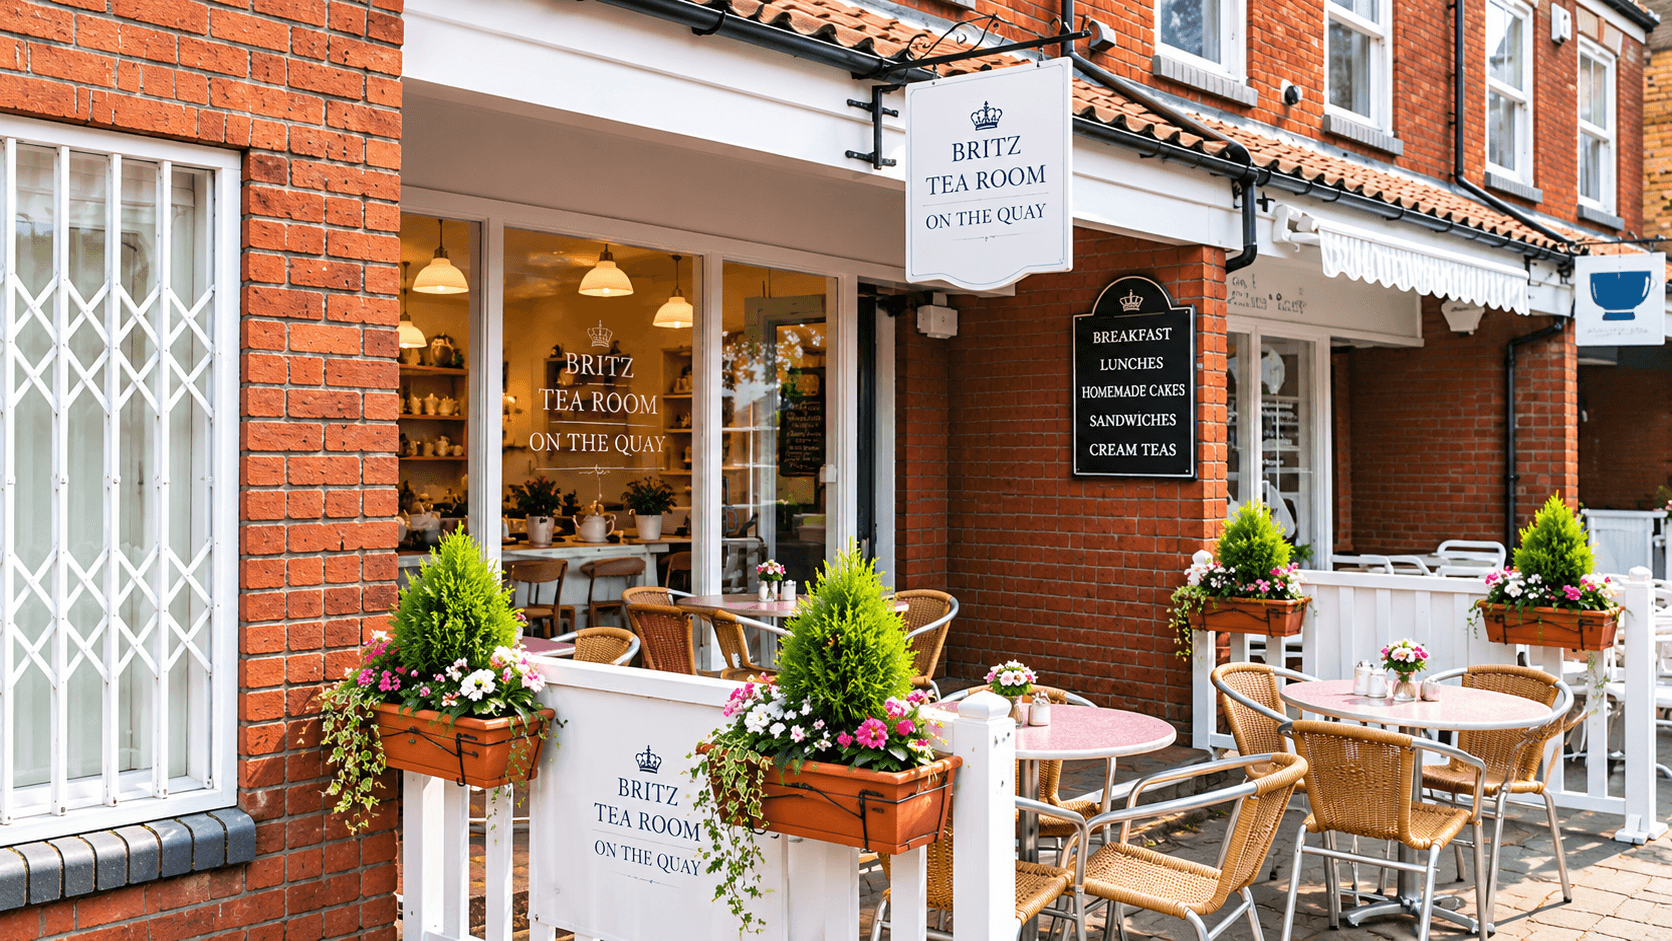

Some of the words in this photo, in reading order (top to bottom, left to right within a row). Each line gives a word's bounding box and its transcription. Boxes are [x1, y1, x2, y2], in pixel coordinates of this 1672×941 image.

[951, 135, 1021, 162] BRITZ
[925, 174, 969, 195] TEA
[976, 164, 1046, 190] ROOM
[925, 213, 951, 229] ON
[956, 209, 992, 226] THE
[997, 203, 1046, 224] QUAY
[1093, 327, 1172, 344] BREAKFAST
[565, 352, 634, 378] BRITZ
[1100, 356, 1164, 371] LUNCHES
[538, 388, 584, 411] TEA
[591, 391, 658, 415] ROOM
[1082, 385, 1146, 398] HOMEMADE
[1149, 383, 1185, 397] CAKES
[1089, 413, 1177, 427] SANDWICHES
[529, 432, 561, 451] ON
[567, 433, 609, 452] THE
[614, 434, 666, 456] QUAY
[1089, 443, 1137, 456] CREAM
[1141, 443, 1177, 456] TEAS
[618, 777, 678, 806] BRITZ
[594, 802, 632, 828] TEA
[638, 811, 701, 842] ROOM
[595, 839, 617, 858] ON
[620, 844, 652, 866] THE
[656, 852, 701, 876] QUAY
